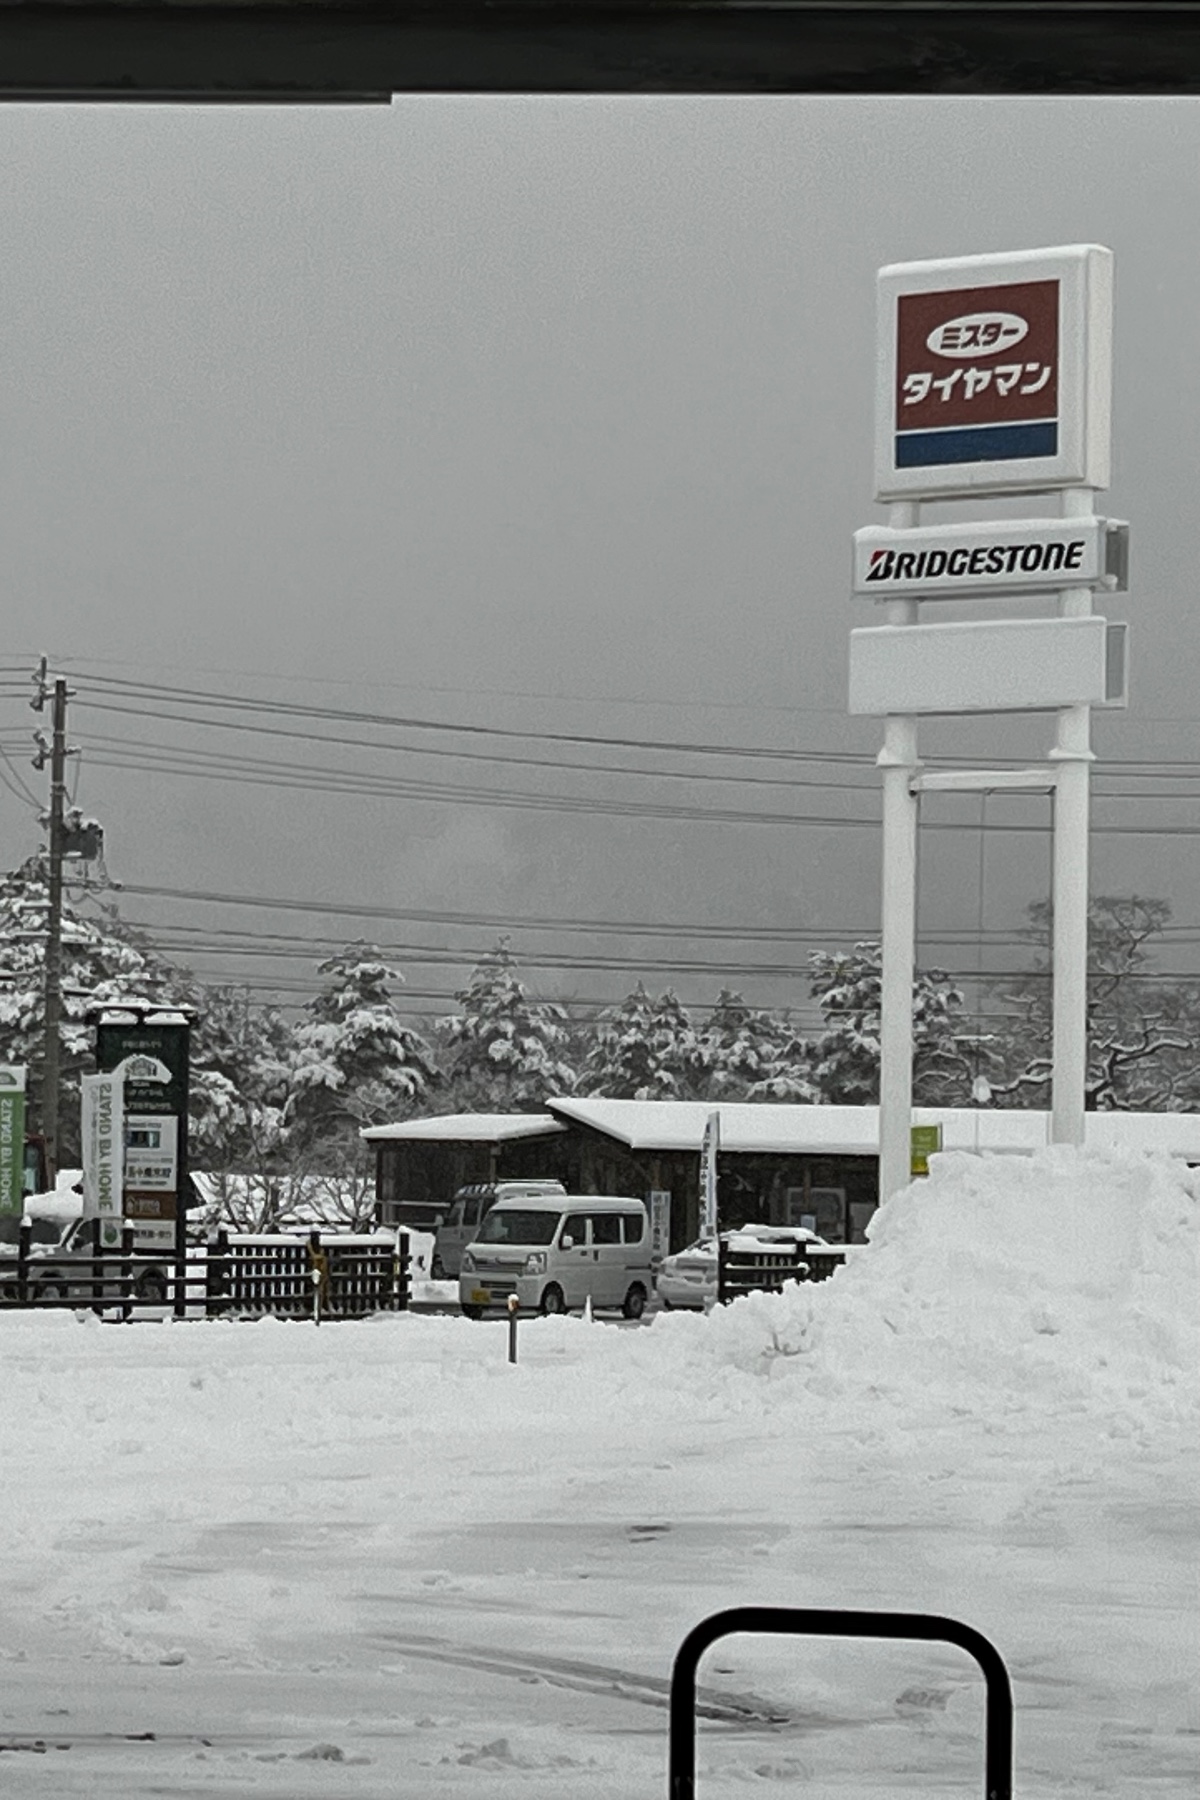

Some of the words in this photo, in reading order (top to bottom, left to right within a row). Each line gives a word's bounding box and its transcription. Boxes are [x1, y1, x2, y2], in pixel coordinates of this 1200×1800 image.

[939, 321, 1021, 350] ミスター
[902, 362, 1051, 405] タイヤマン
[865, 540, 1087, 582] BRIDGESTONE
